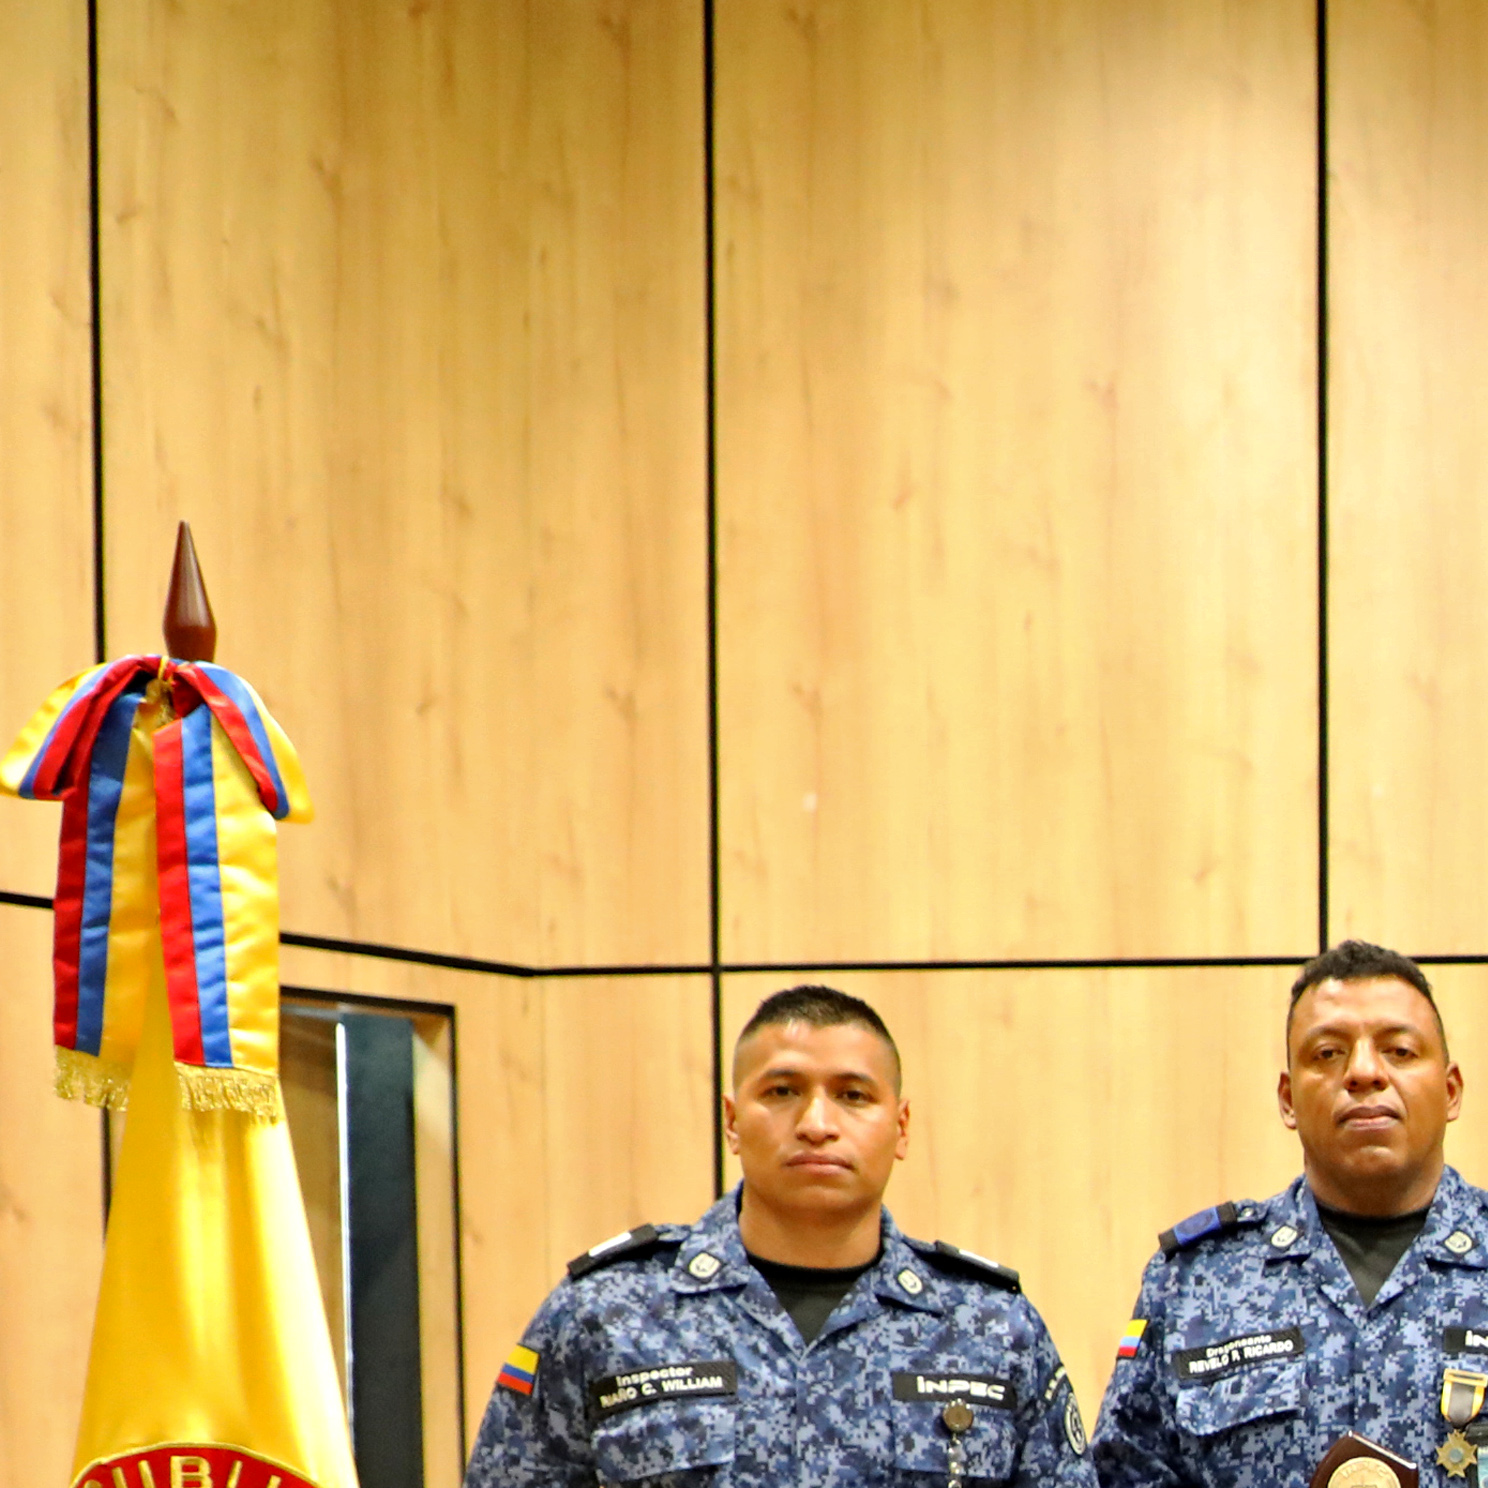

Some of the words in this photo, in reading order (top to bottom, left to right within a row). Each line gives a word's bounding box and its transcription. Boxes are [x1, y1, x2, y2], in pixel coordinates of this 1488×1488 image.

[1188, 1353, 1229, 1374] REVELO
[1243, 1339, 1294, 1359] RICARDO
[616, 1366, 693, 1386] Inspector
[661, 1376, 723, 1393] WILLIAM
